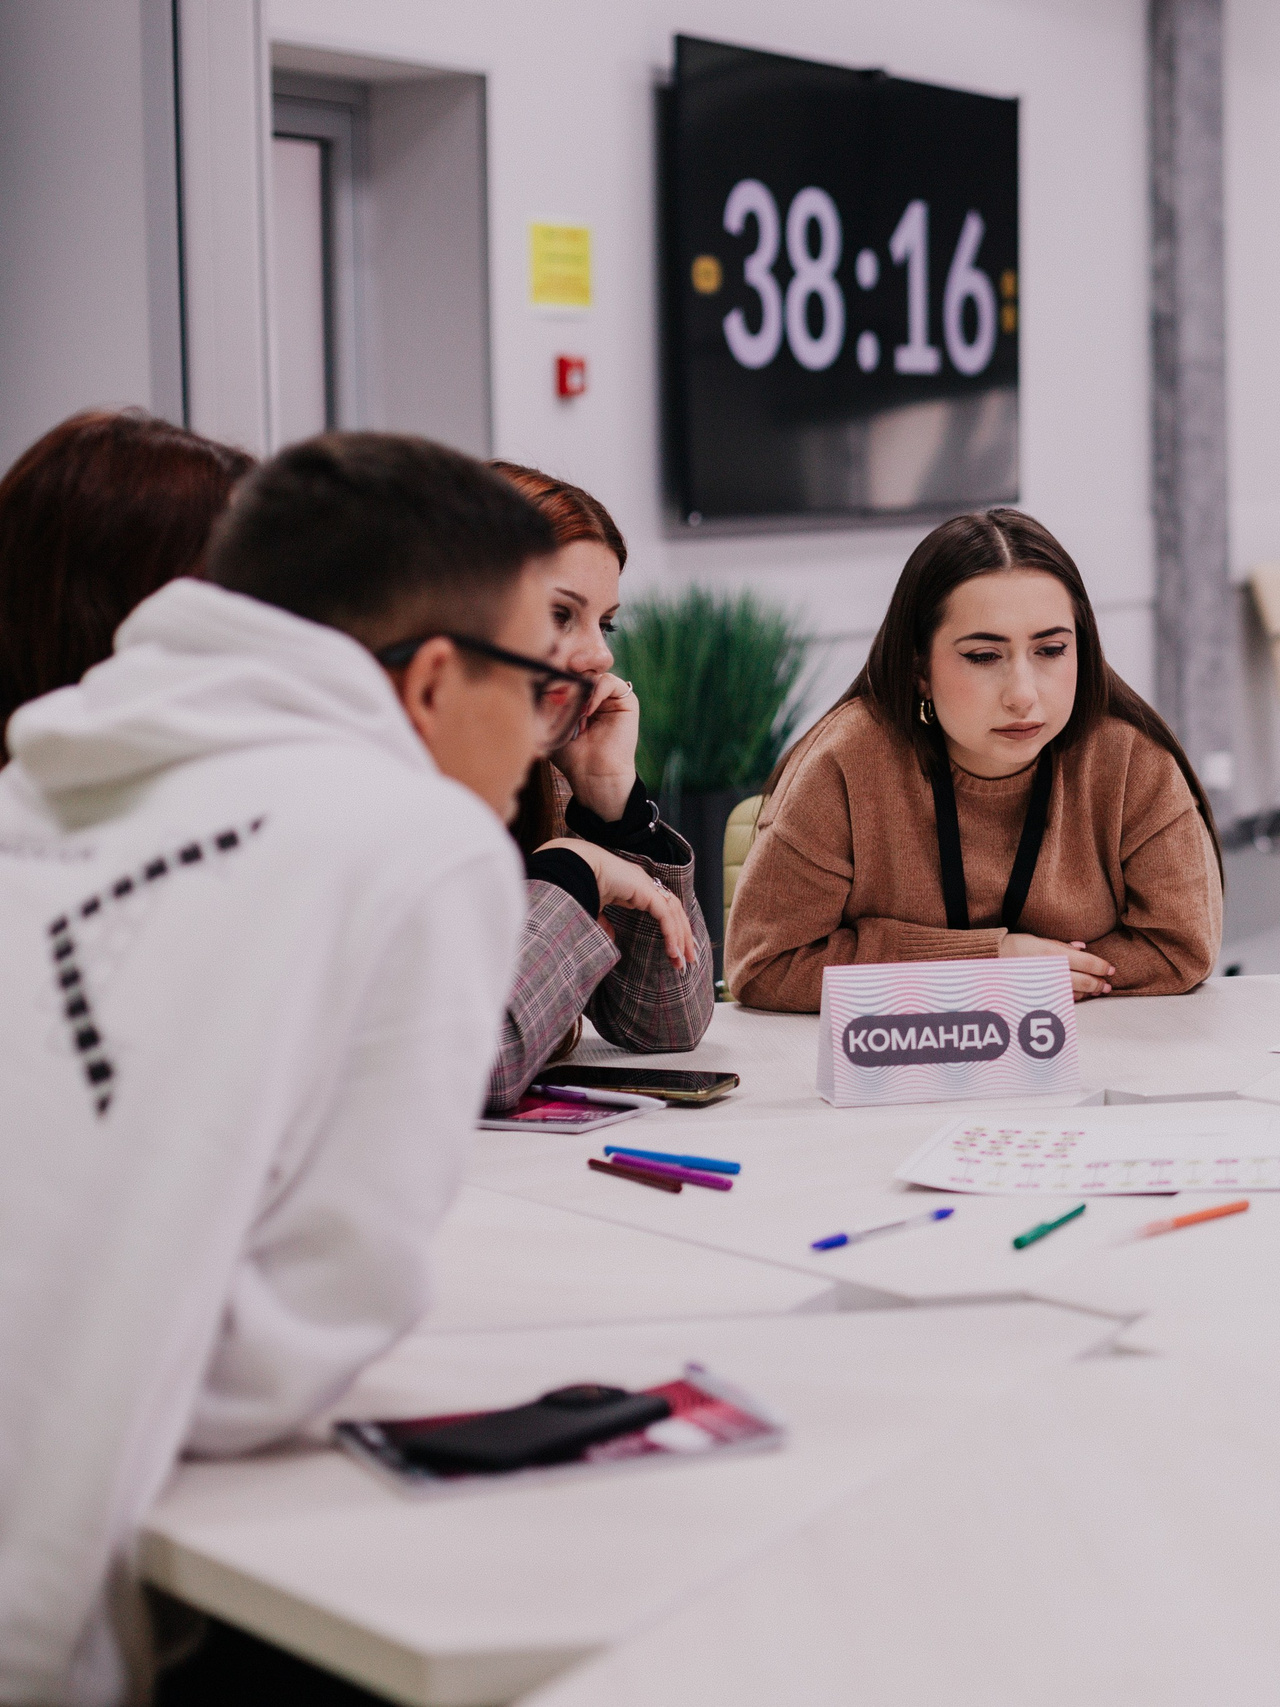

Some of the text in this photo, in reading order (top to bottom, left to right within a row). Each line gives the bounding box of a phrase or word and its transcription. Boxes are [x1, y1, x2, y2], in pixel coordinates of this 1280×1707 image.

[722, 177, 998, 376] 38:16
[848, 1017, 1056, 1053] КОМАНДА 5
